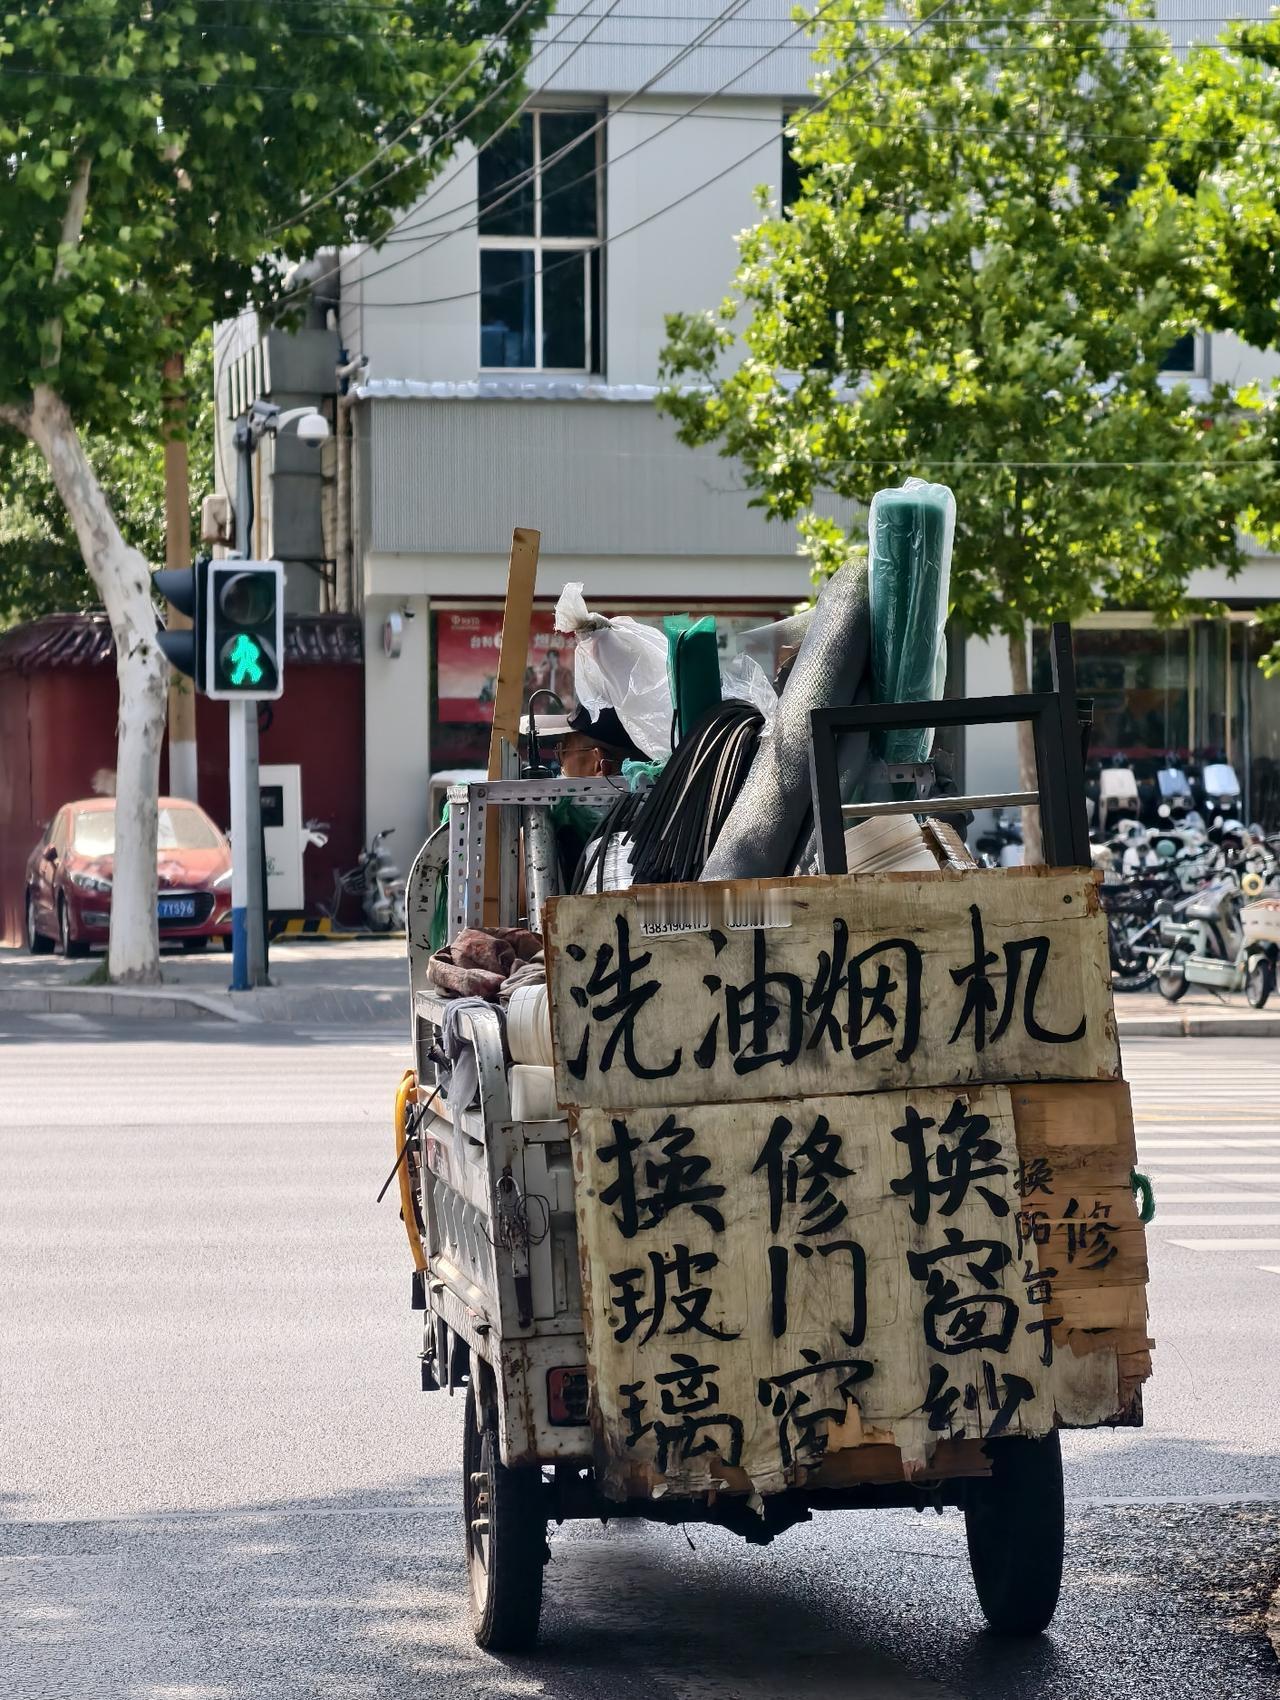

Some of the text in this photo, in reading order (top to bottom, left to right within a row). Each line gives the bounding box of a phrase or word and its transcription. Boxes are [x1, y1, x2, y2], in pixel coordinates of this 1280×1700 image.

[568, 903, 1087, 1080] 洗油烟机
[599, 1113, 745, 1473] 换玻璃
